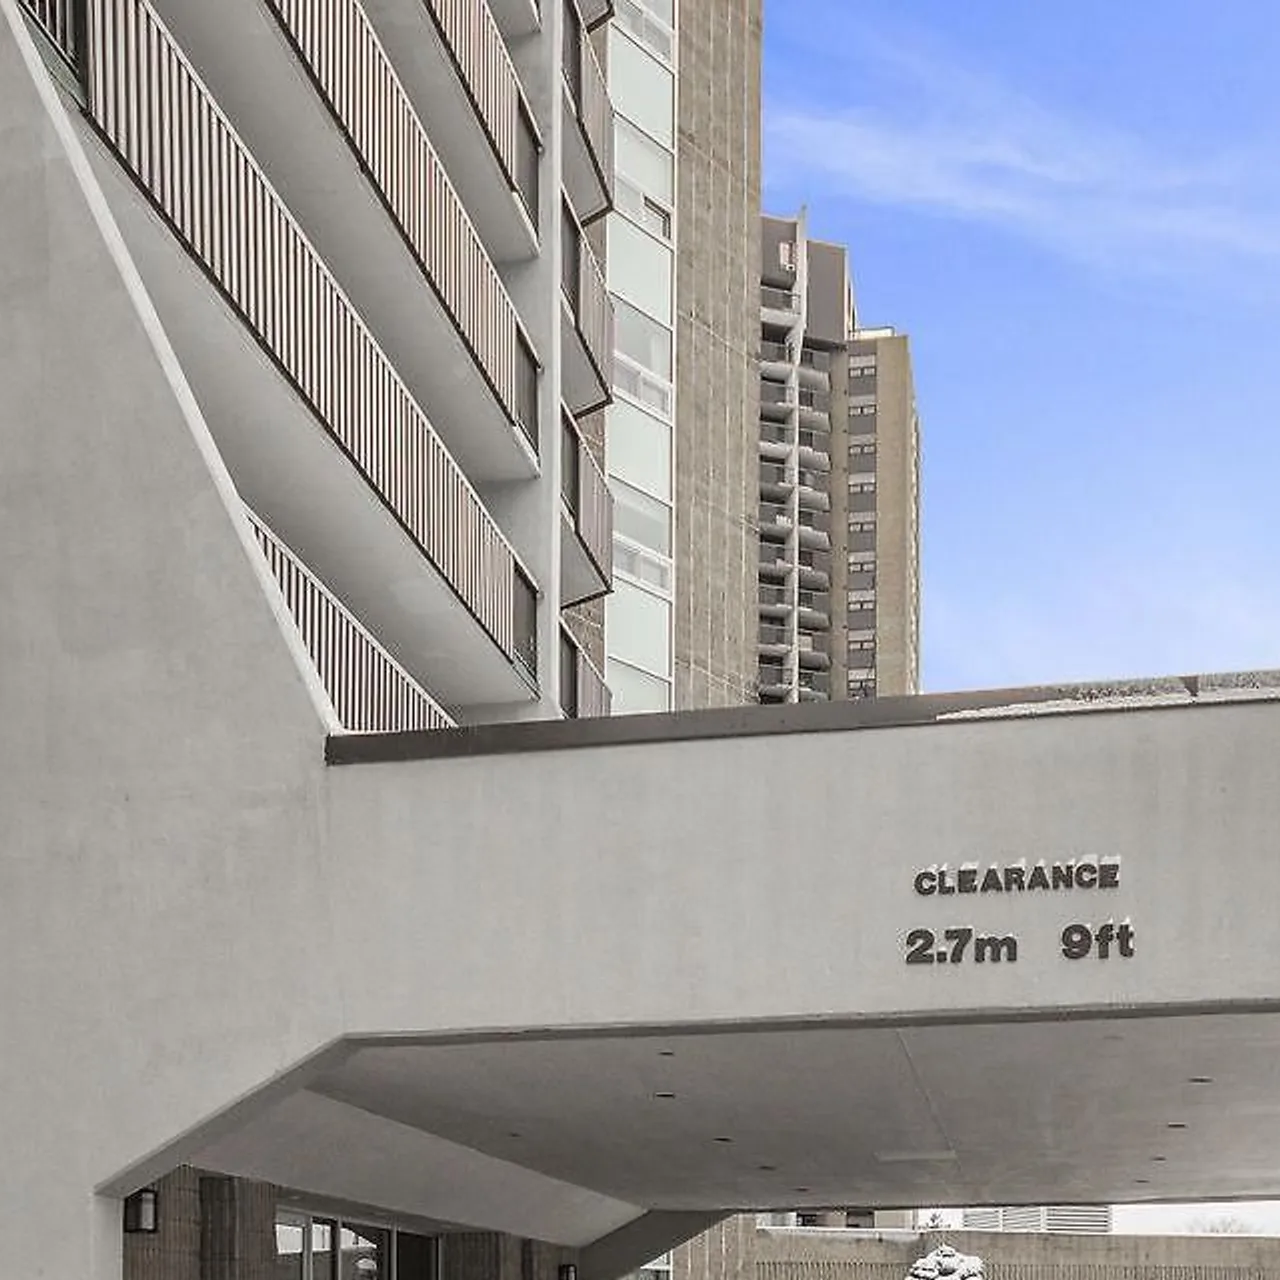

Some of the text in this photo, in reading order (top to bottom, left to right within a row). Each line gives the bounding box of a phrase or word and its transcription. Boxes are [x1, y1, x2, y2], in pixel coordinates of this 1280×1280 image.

[914, 863, 1120, 895] CLEARANCE
[905, 922, 1135, 964] 2.7m 9ft
